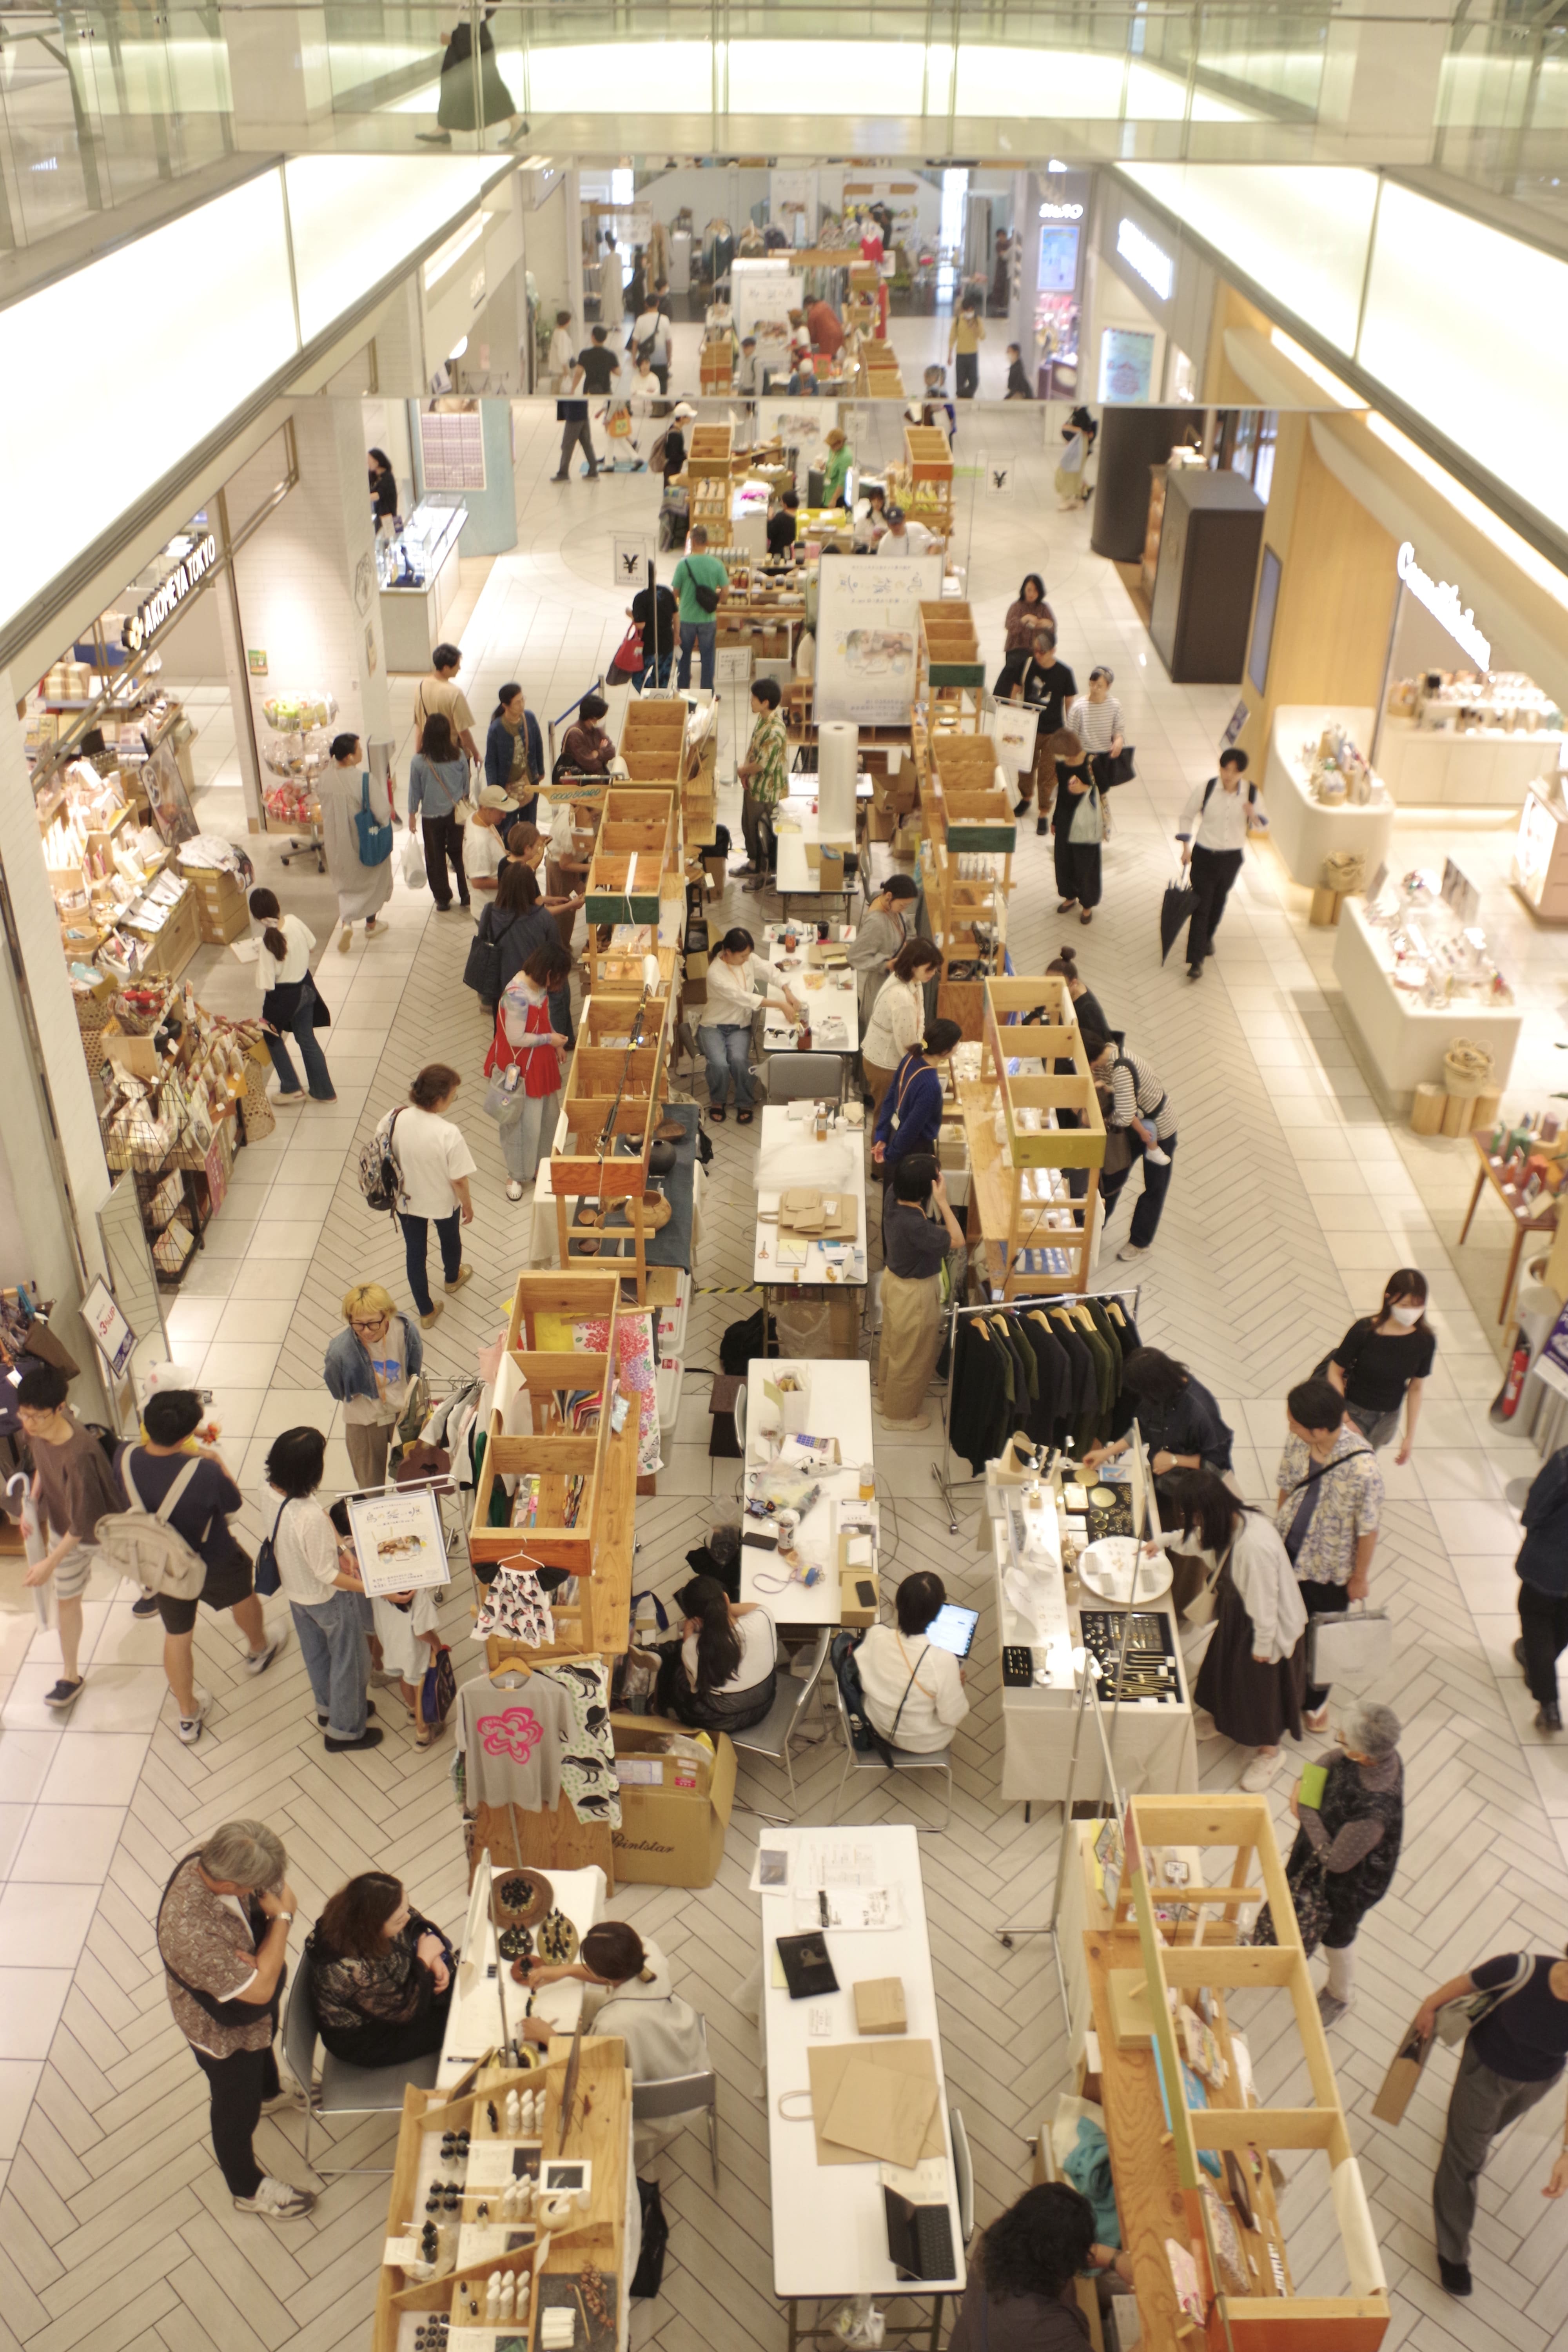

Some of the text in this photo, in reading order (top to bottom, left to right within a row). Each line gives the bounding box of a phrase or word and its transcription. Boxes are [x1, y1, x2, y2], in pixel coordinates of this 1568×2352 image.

[994, 470, 1007, 489] ¥
[622, 553, 639, 573] ¥
[145, 534, 215, 639] AKOMEYA TOKYO
[550, 791, 573, 800] GOOD
[612, 1831, 675, 1853] Printstar
